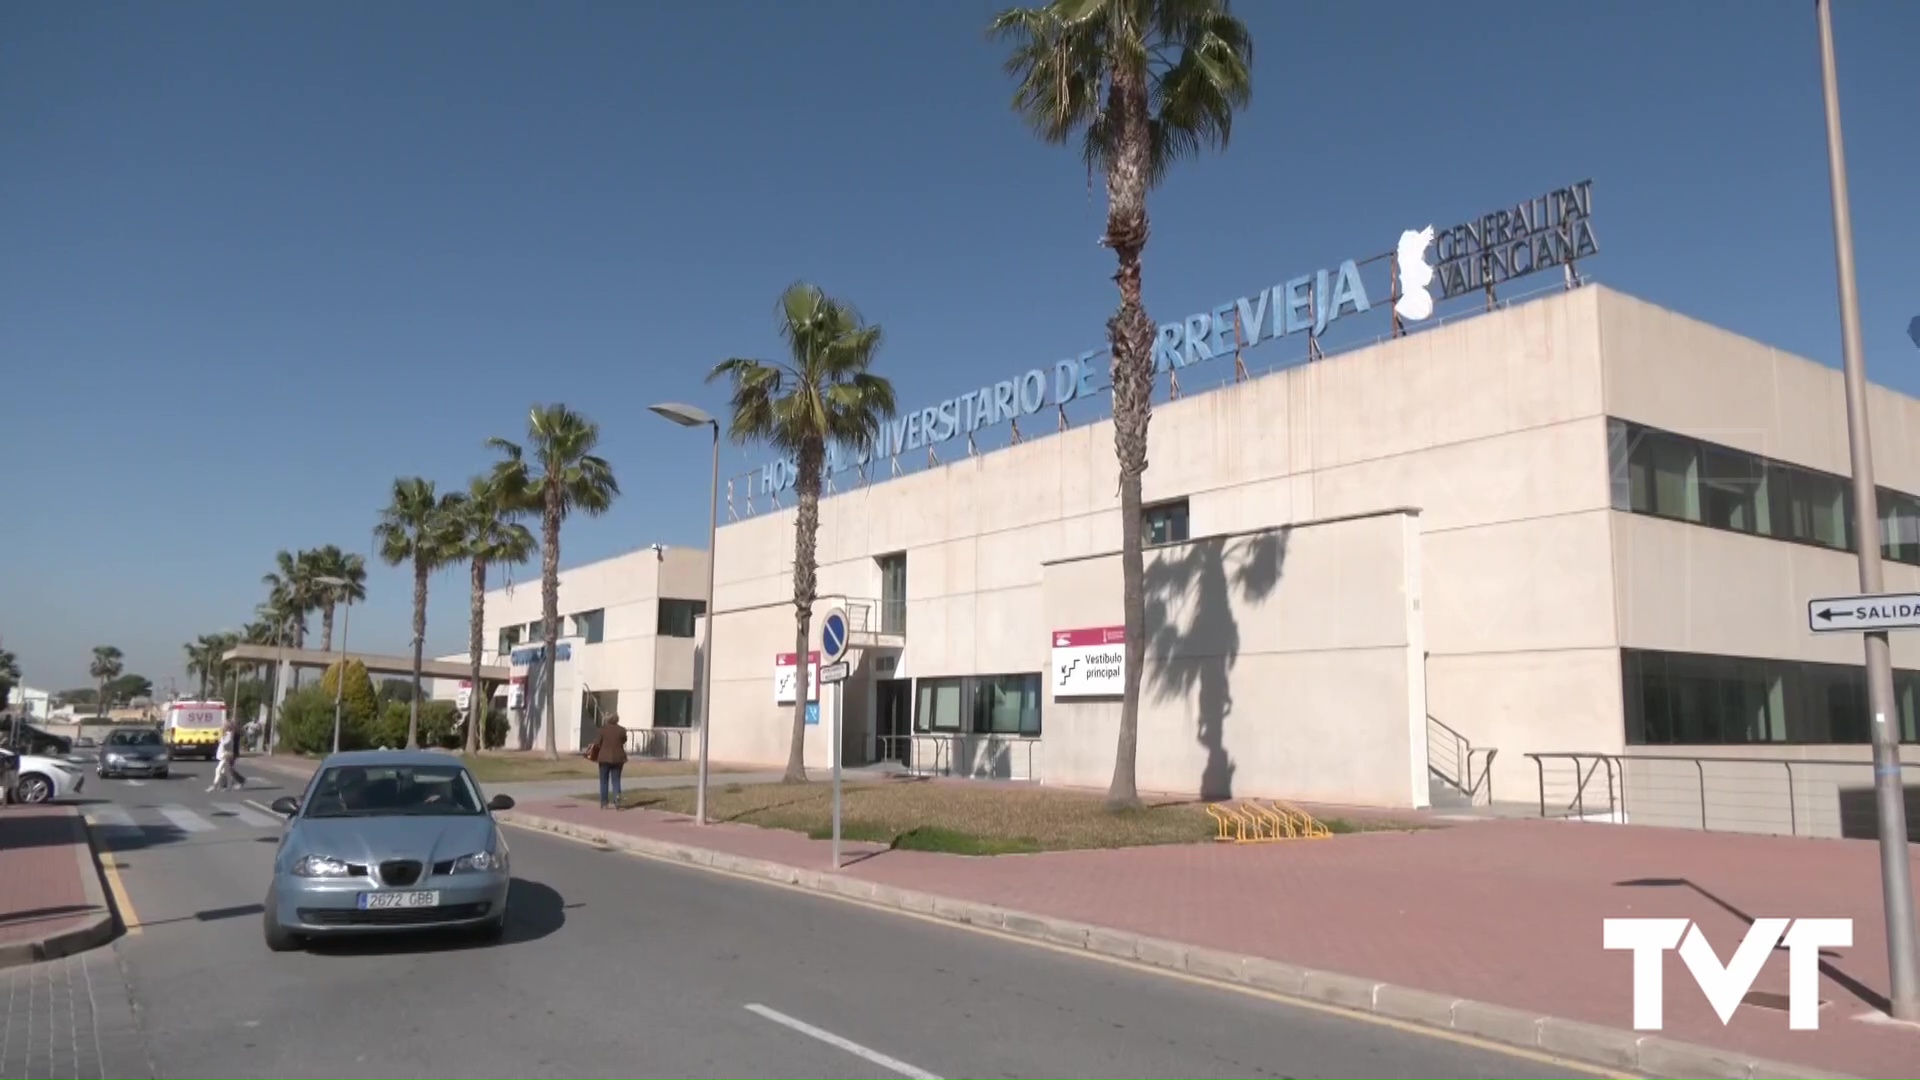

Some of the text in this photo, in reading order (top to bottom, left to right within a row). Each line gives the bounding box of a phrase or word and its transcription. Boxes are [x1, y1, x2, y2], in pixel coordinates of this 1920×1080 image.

[1437, 178, 1592, 264] GENERALITAT
[1438, 221, 1598, 299] VALENCIANA
[761, 438, 848, 495] HOSAL
[1055, 350, 1097, 405] DE
[1150, 258, 1371, 374] RREVIEJA
[1856, 603, 1920, 620] SALIDA
[1086, 666, 1120, 680] principal
[188, 712, 213, 722] SVB
[370, 893, 403, 907] 2672
